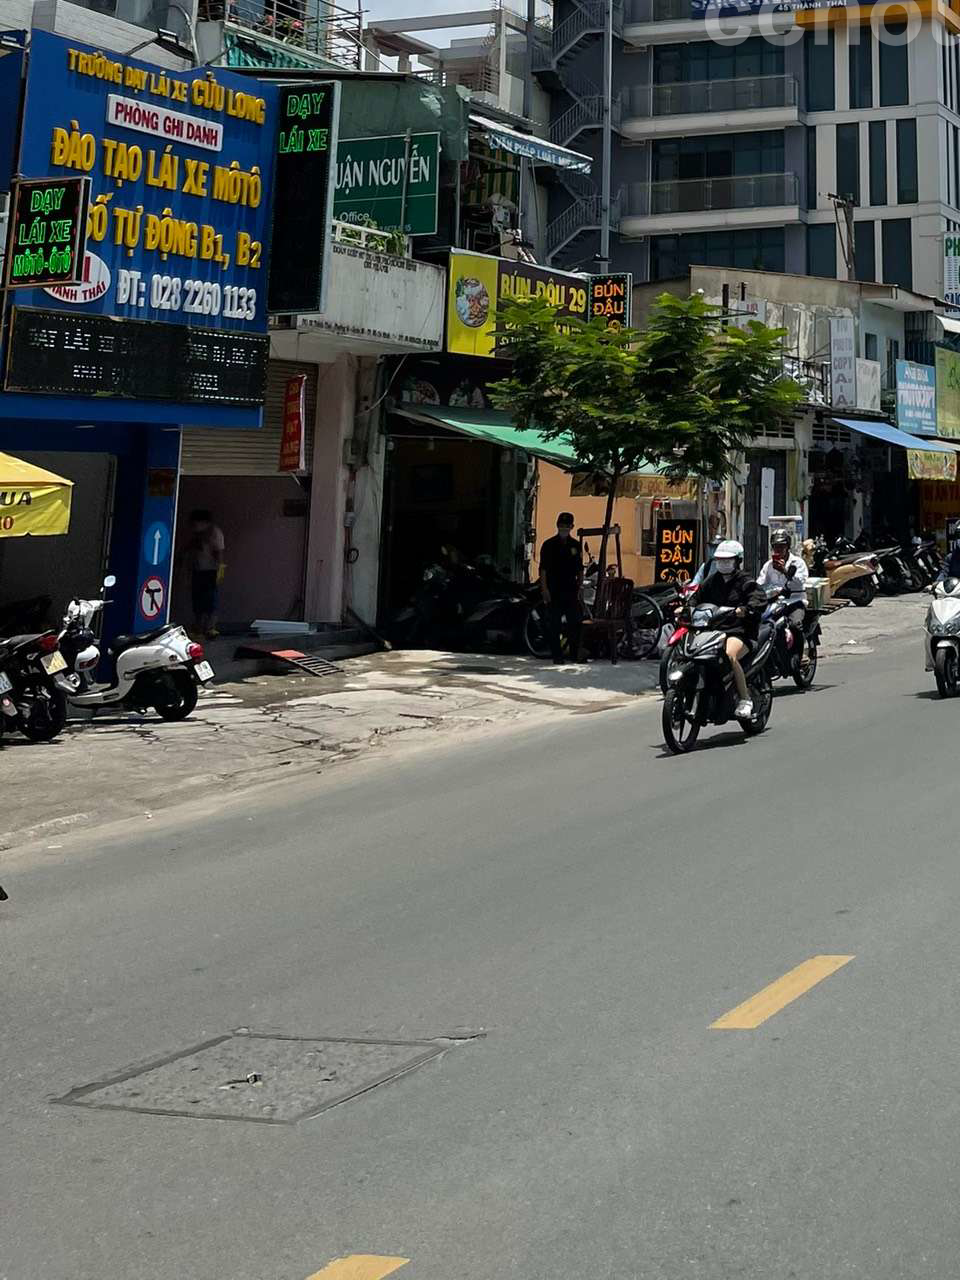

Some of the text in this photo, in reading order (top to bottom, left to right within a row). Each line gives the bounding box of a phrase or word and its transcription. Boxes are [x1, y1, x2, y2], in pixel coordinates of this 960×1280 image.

[68, 48, 266, 126] TRƯỜNG DẠY LÁI XE CỬU LONG
[286, 92, 325, 119] DẠY
[115, 102, 218, 147] PHÒNG GHI DANH
[279, 124, 329, 153] LÁI XE
[51, 119, 262, 209] ĐÀO TẠO LÁI XE MÔTÔ
[335, 154, 364, 195] UẬN
[30, 187, 66, 215] DẠY
[339, 209, 370, 222] Office
[18, 216, 72, 245] LÁI XE
[112, 205, 144, 257] TỰ
[143, 207, 198, 261] ĐỘNG
[236, 231, 262, 268] B2
[82, 281, 106, 300] THÁI
[117, 269, 146, 307] ĐT:
[150, 274, 182, 311] 028
[182, 279, 221, 316] 2260
[222, 285, 257, 321] 1133
[501, 270, 532, 299] BÚN
[569, 287, 587, 313] 29
[594, 280, 624, 298] BÚN
[593, 298, 624, 317] ĐẬU
[0, 491, 32, 506] UA
[661, 524, 693, 544] BÚN
[660, 545, 693, 565] ĐẬU
